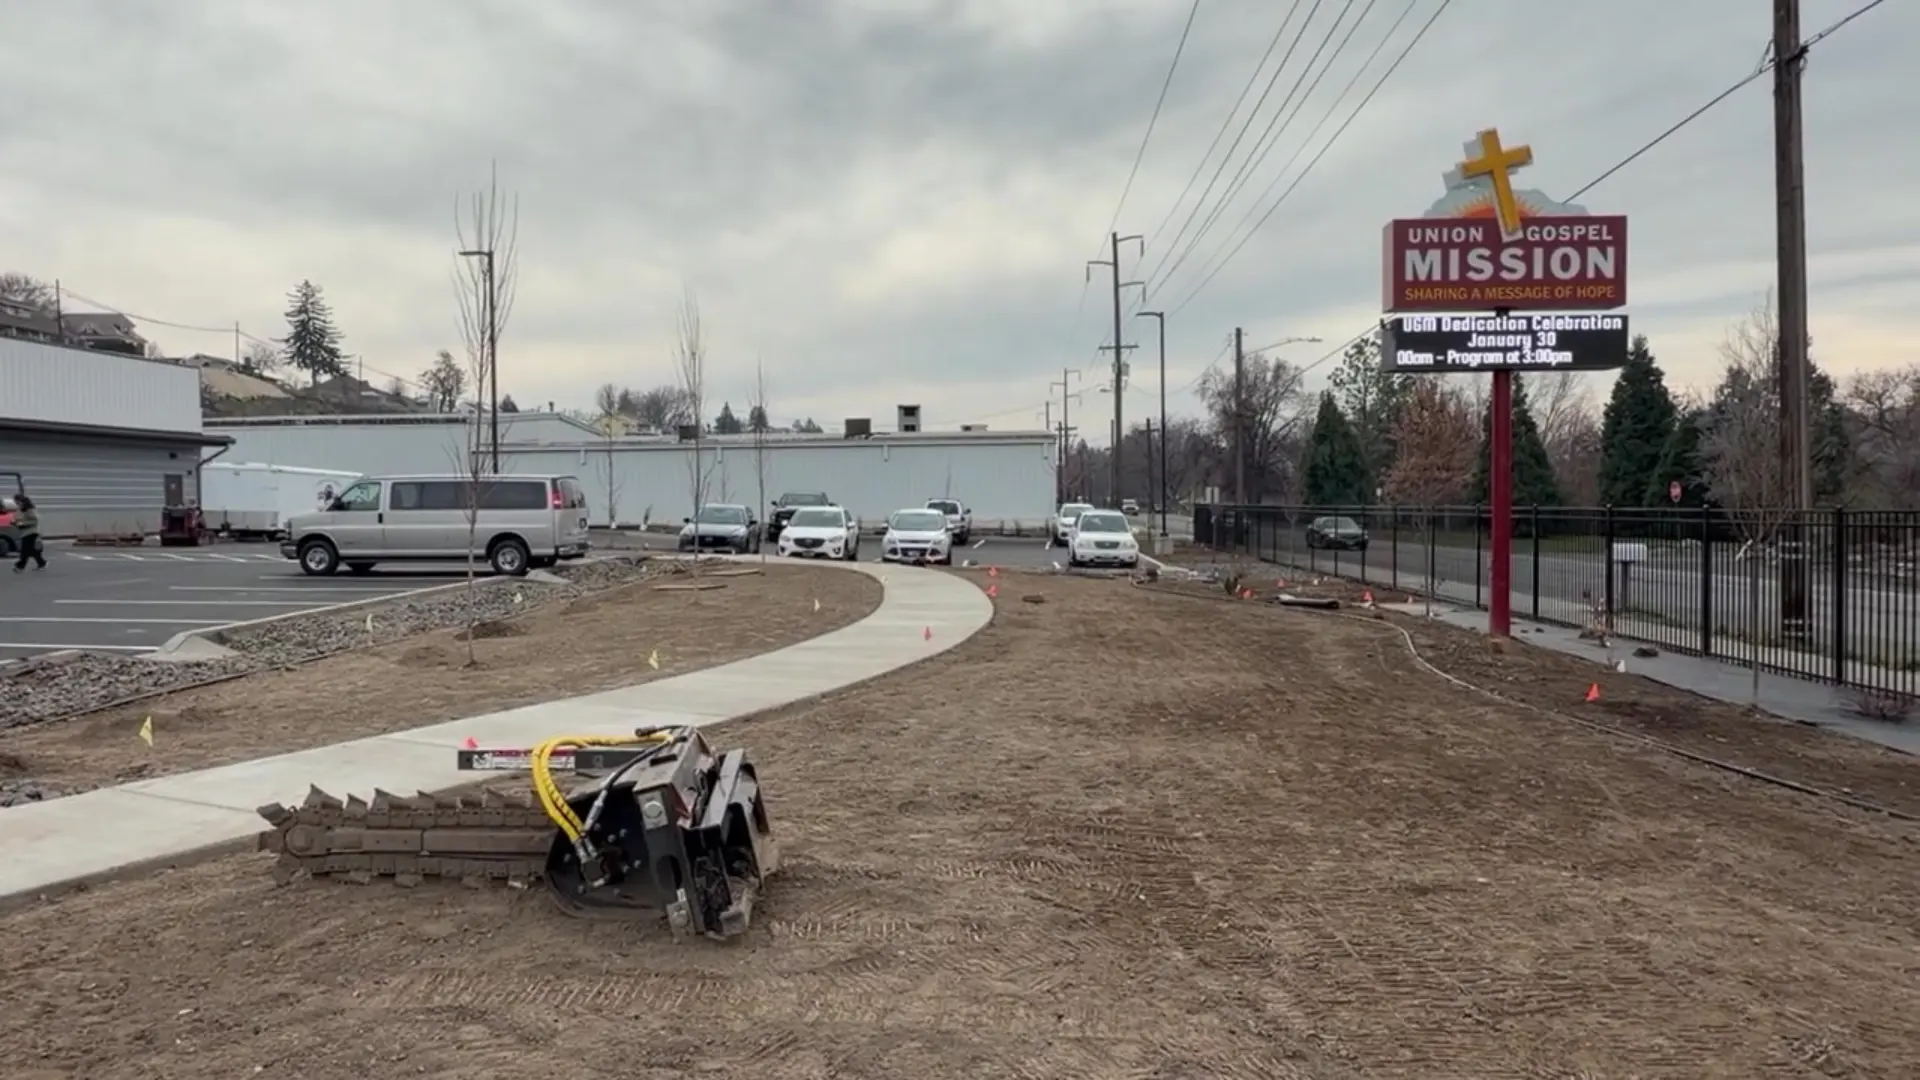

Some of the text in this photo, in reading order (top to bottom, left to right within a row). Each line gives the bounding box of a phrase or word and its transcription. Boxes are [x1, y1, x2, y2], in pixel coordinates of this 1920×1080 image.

[1408, 224, 1613, 243] UNION GOSPEL
[1405, 246, 1615, 281] MISSION
[1405, 285, 1615, 300] SHARING A MESSAGE OF HOPE
[1403, 315, 1622, 332] UGM Dedication Celebration
[1467, 331, 1556, 349] January 30
[1447, 349, 1503, 367] Program
[1506, 351, 1520, 364] at
[1522, 348, 1572, 366] 3:00pm
